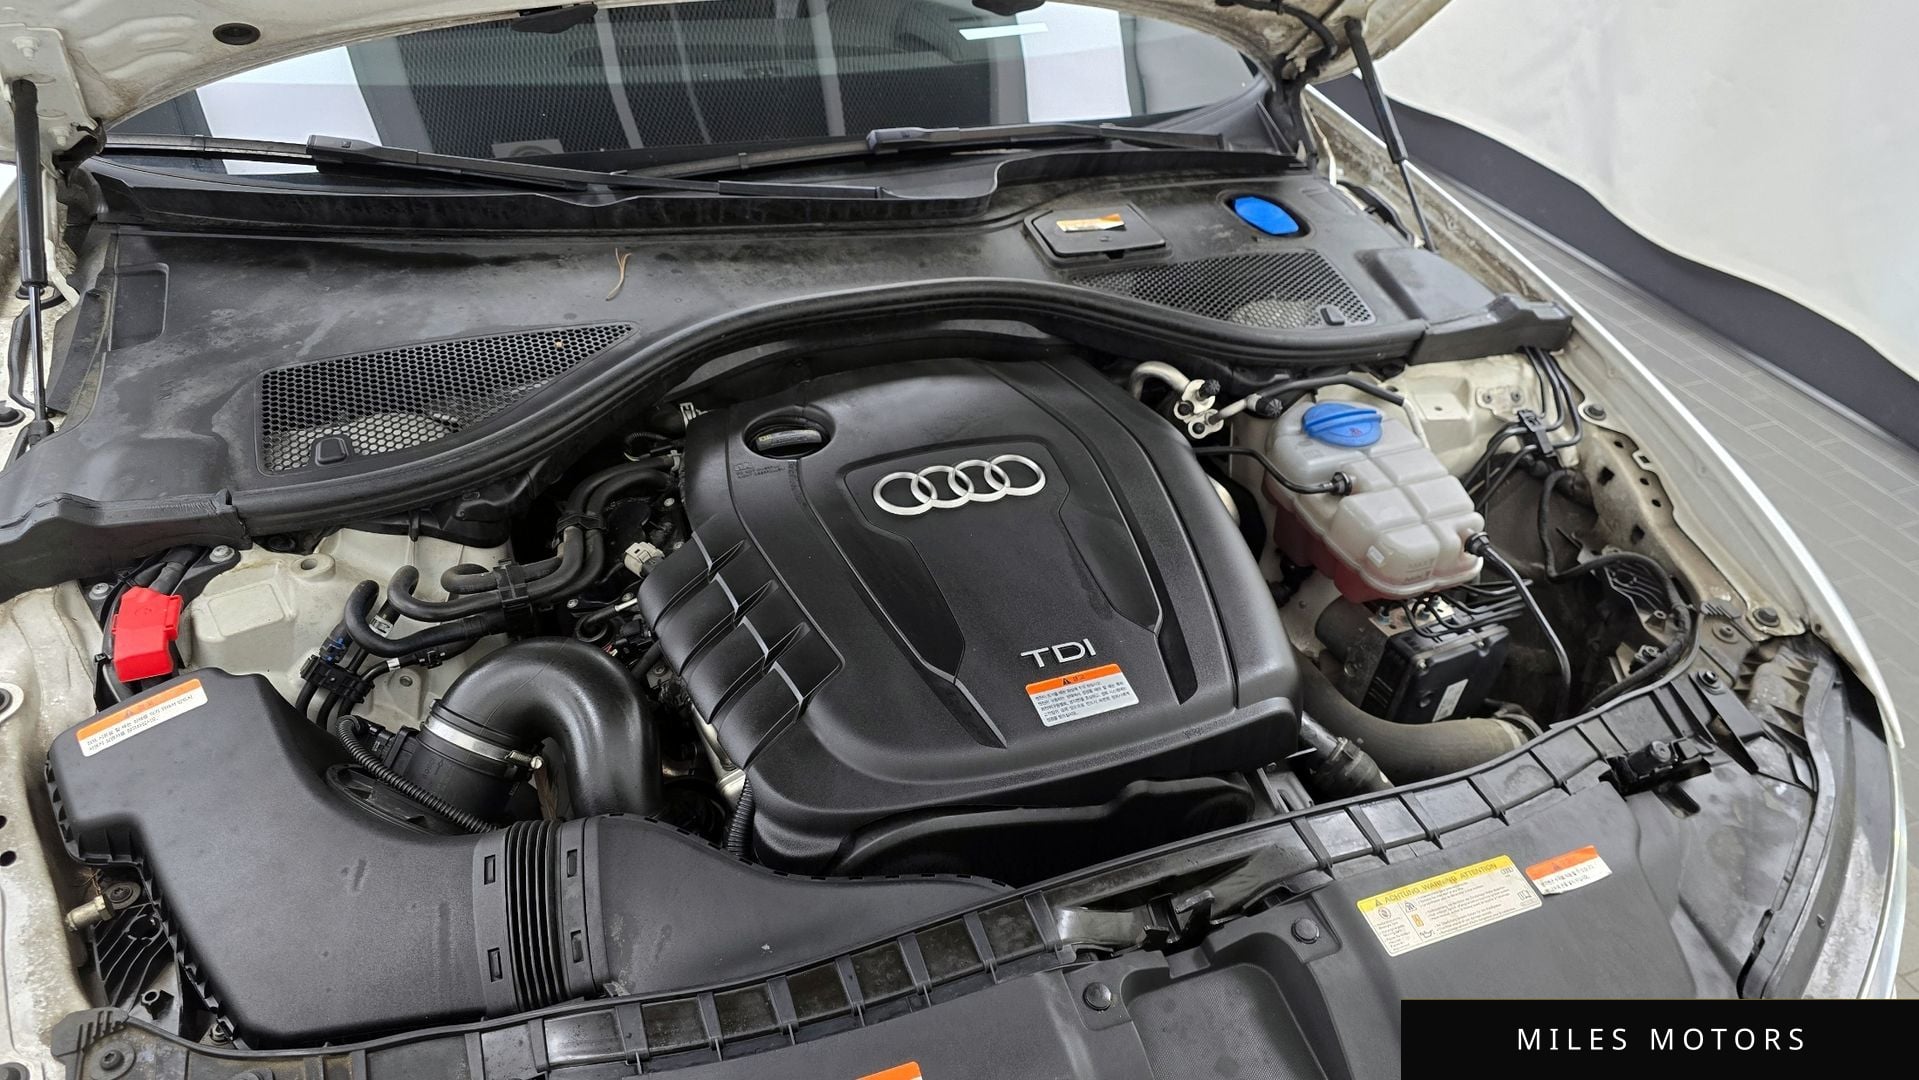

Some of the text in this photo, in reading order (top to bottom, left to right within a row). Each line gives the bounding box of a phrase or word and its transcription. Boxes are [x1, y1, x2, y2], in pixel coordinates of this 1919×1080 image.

[1020, 638, 1097, 668] TDI
[1384, 887, 1421, 903] ACHTUNG
[1422, 876, 1458, 891] WARNING
[1460, 863, 1498, 879] ATTENTION
